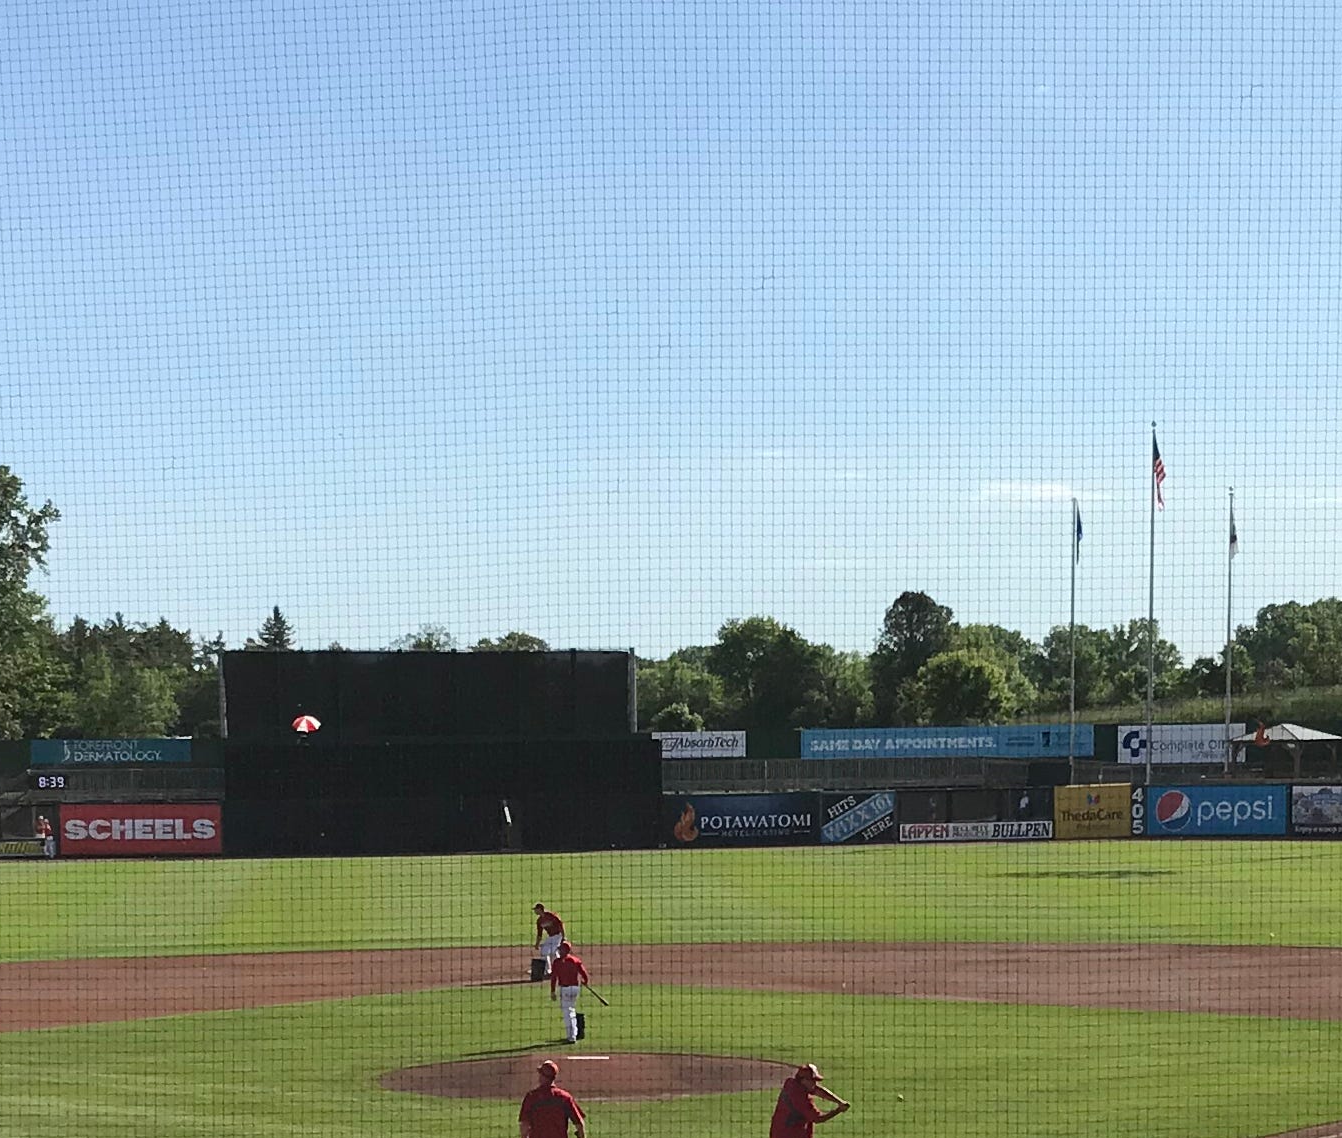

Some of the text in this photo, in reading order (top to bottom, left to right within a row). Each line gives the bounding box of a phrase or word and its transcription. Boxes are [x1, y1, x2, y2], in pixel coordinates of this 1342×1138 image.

[677, 736, 738, 749] AbsorbTech
[810, 739, 849, 752] SAME
[851, 738, 881, 751] DAY
[1151, 739, 1205, 753] Complete
[74, 750, 162, 762] DERMATOLOGY
[38, 776, 65, 788] 8:39
[827, 795, 857, 819] HITS
[1062, 808, 1123, 821] ThedaCare
[1131, 787, 1144, 834] 405
[1198, 796, 1273, 827] pepsi
[700, 813, 812, 829] POTAWATOMI
[861, 816, 894, 840] HERE
[64, 818, 216, 840] SCHEELS
[901, 824, 949, 839] LAPPEN
[991, 822, 1052, 838] BULLPEN
